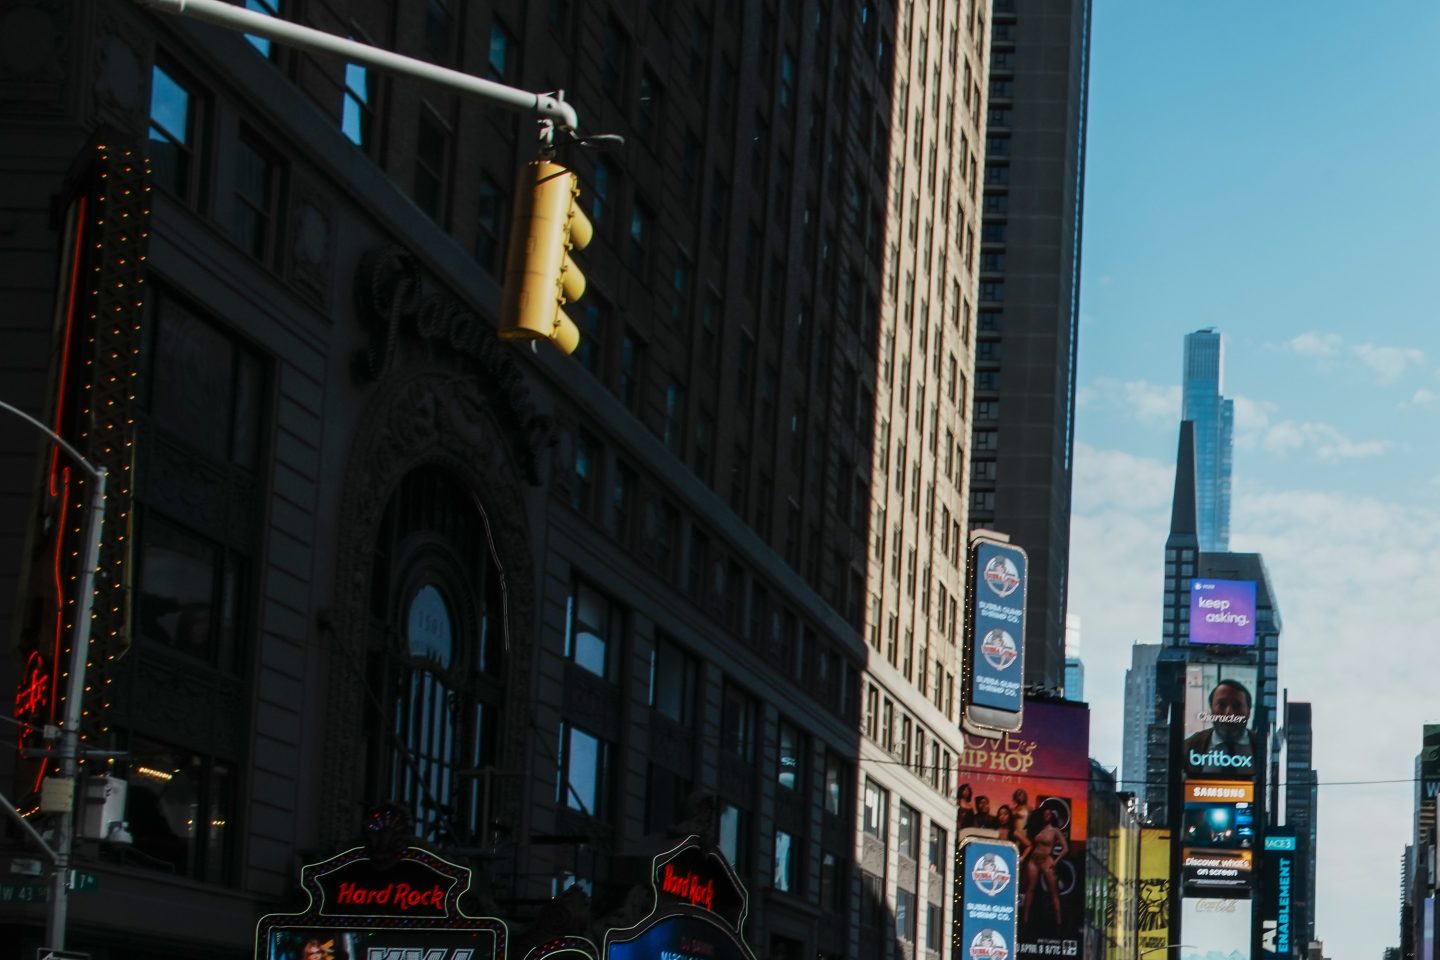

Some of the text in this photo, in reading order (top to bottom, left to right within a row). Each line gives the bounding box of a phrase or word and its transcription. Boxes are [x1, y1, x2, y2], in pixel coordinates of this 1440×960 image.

[1198, 597, 1230, 612] keep
[1206, 611, 1250, 627] asking.
[1196, 711, 1247, 724] Character.
[990, 752, 1034, 773] HOP
[1189, 749, 1253, 768] britbox
[1193, 787, 1246, 798] SAMSUNG
[1186, 858, 1220, 867] Discover
[19, 887, 33, 901] 43
[338, 883, 447, 910] Hard Rock
[1279, 858, 1291, 953] ENABLEMENT
